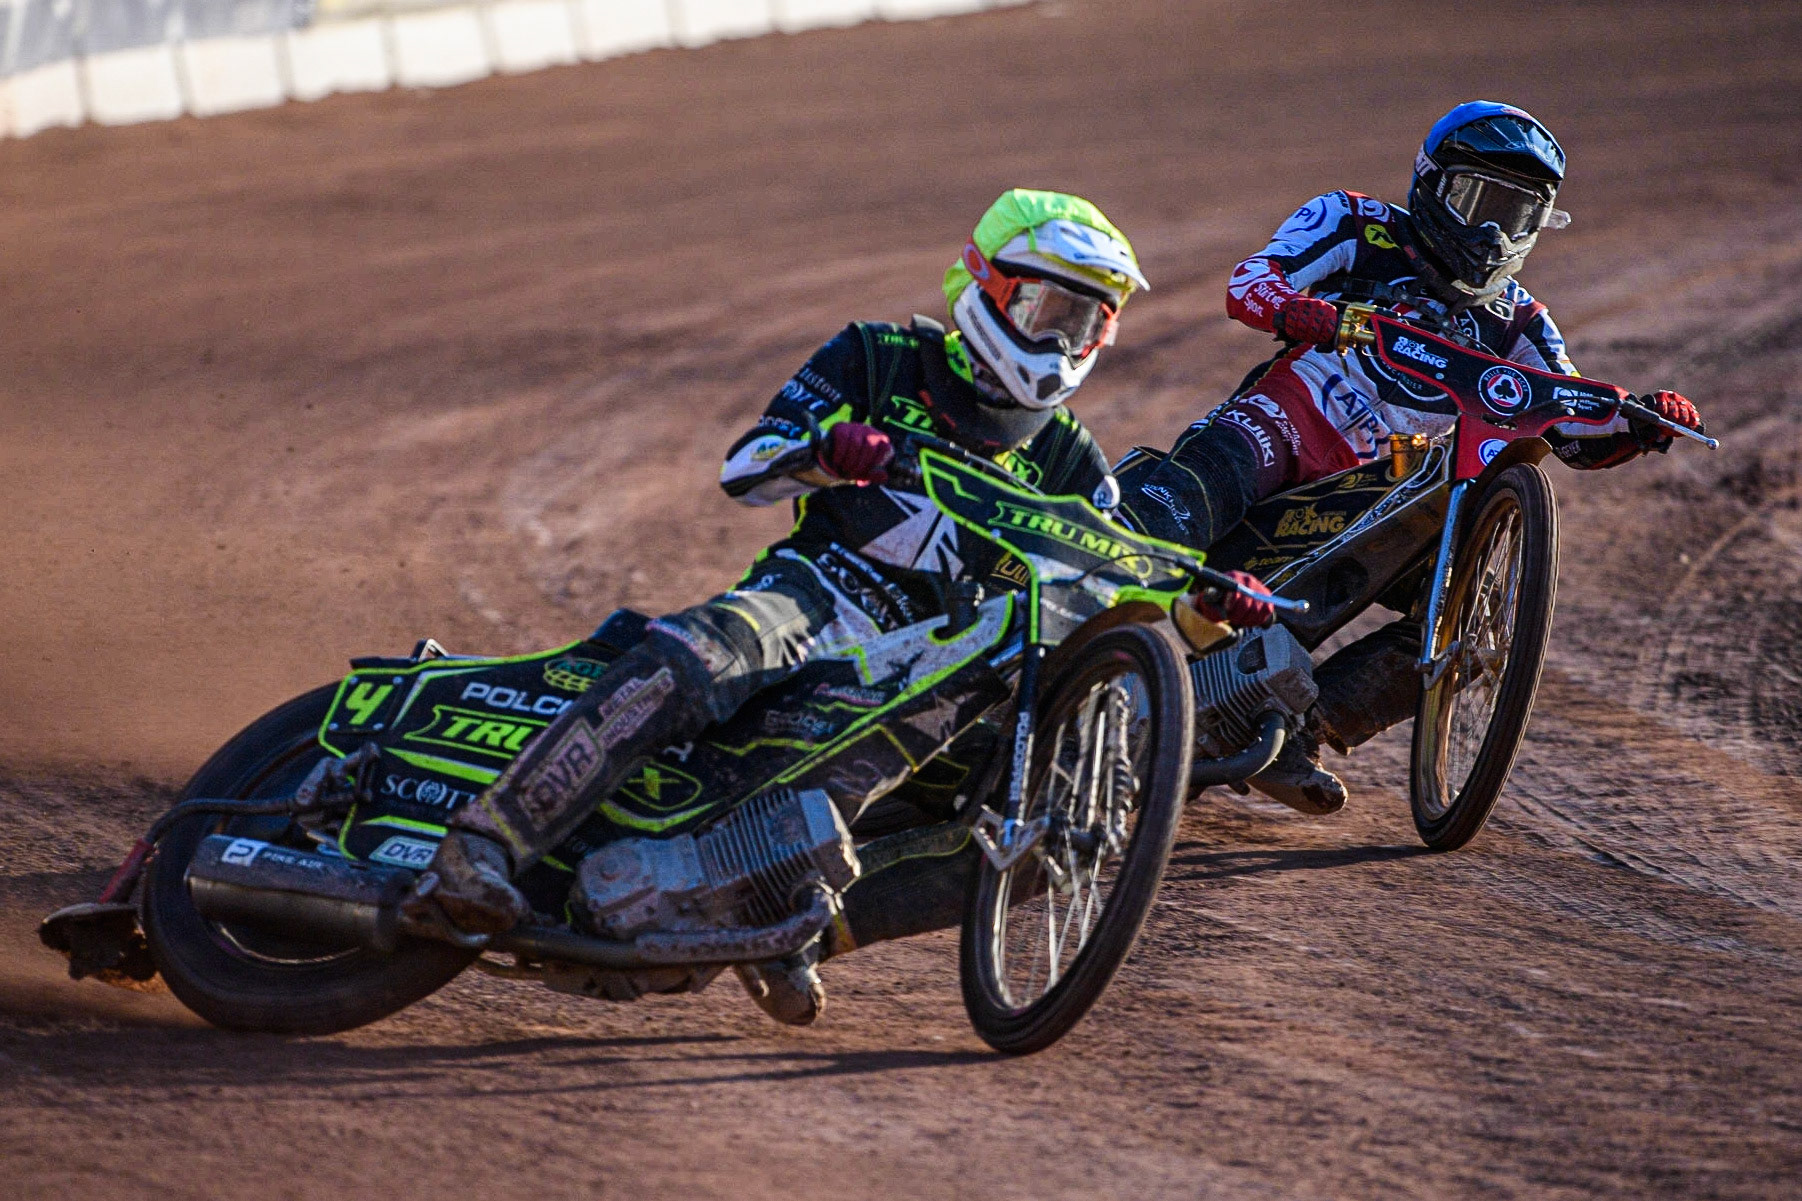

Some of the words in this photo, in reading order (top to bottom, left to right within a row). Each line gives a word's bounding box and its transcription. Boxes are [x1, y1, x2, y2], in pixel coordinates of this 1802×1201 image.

[1392, 341, 1448, 369] RACING
[1273, 515, 1346, 538] RACING
[344, 681, 395, 726] 4
[383, 841, 434, 862] DVR
